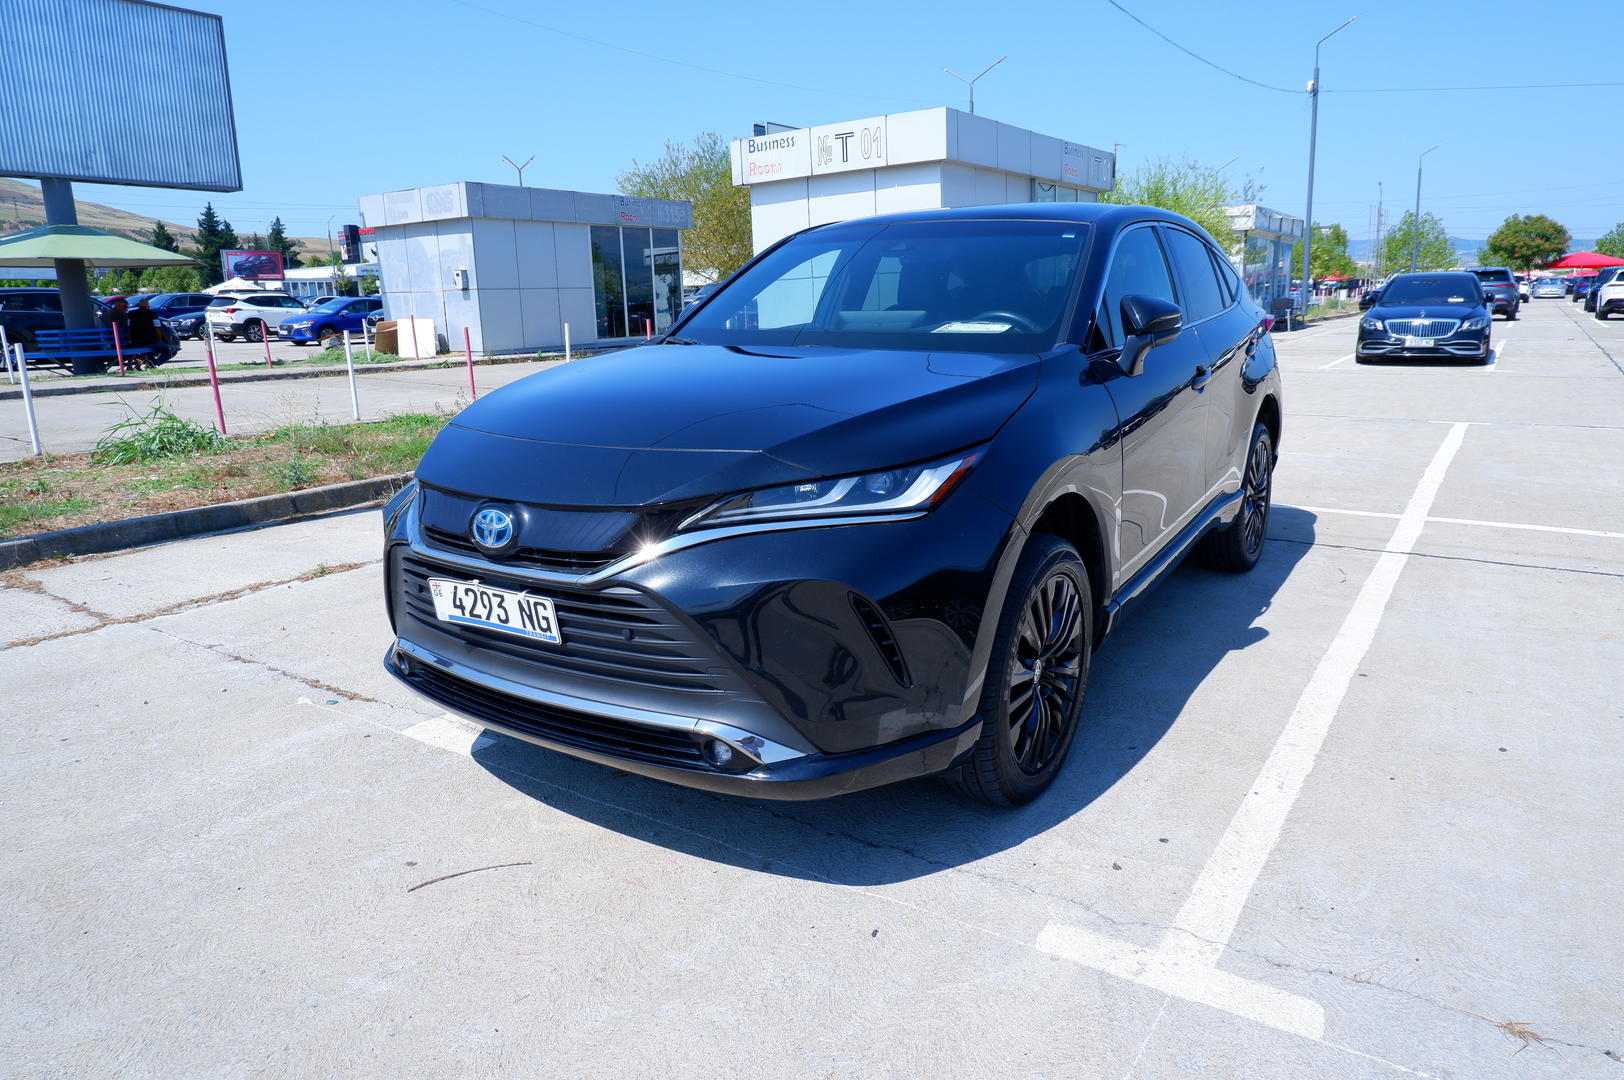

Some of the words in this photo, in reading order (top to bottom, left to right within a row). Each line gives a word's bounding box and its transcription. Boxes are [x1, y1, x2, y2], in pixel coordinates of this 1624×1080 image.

[748, 136, 795, 153] Business
[835, 132, 854, 163] T
[861, 127, 882, 160] 01
[433, 589, 443, 598] GE
[452, 585, 510, 625] 4293
[517, 599, 553, 634] NG
